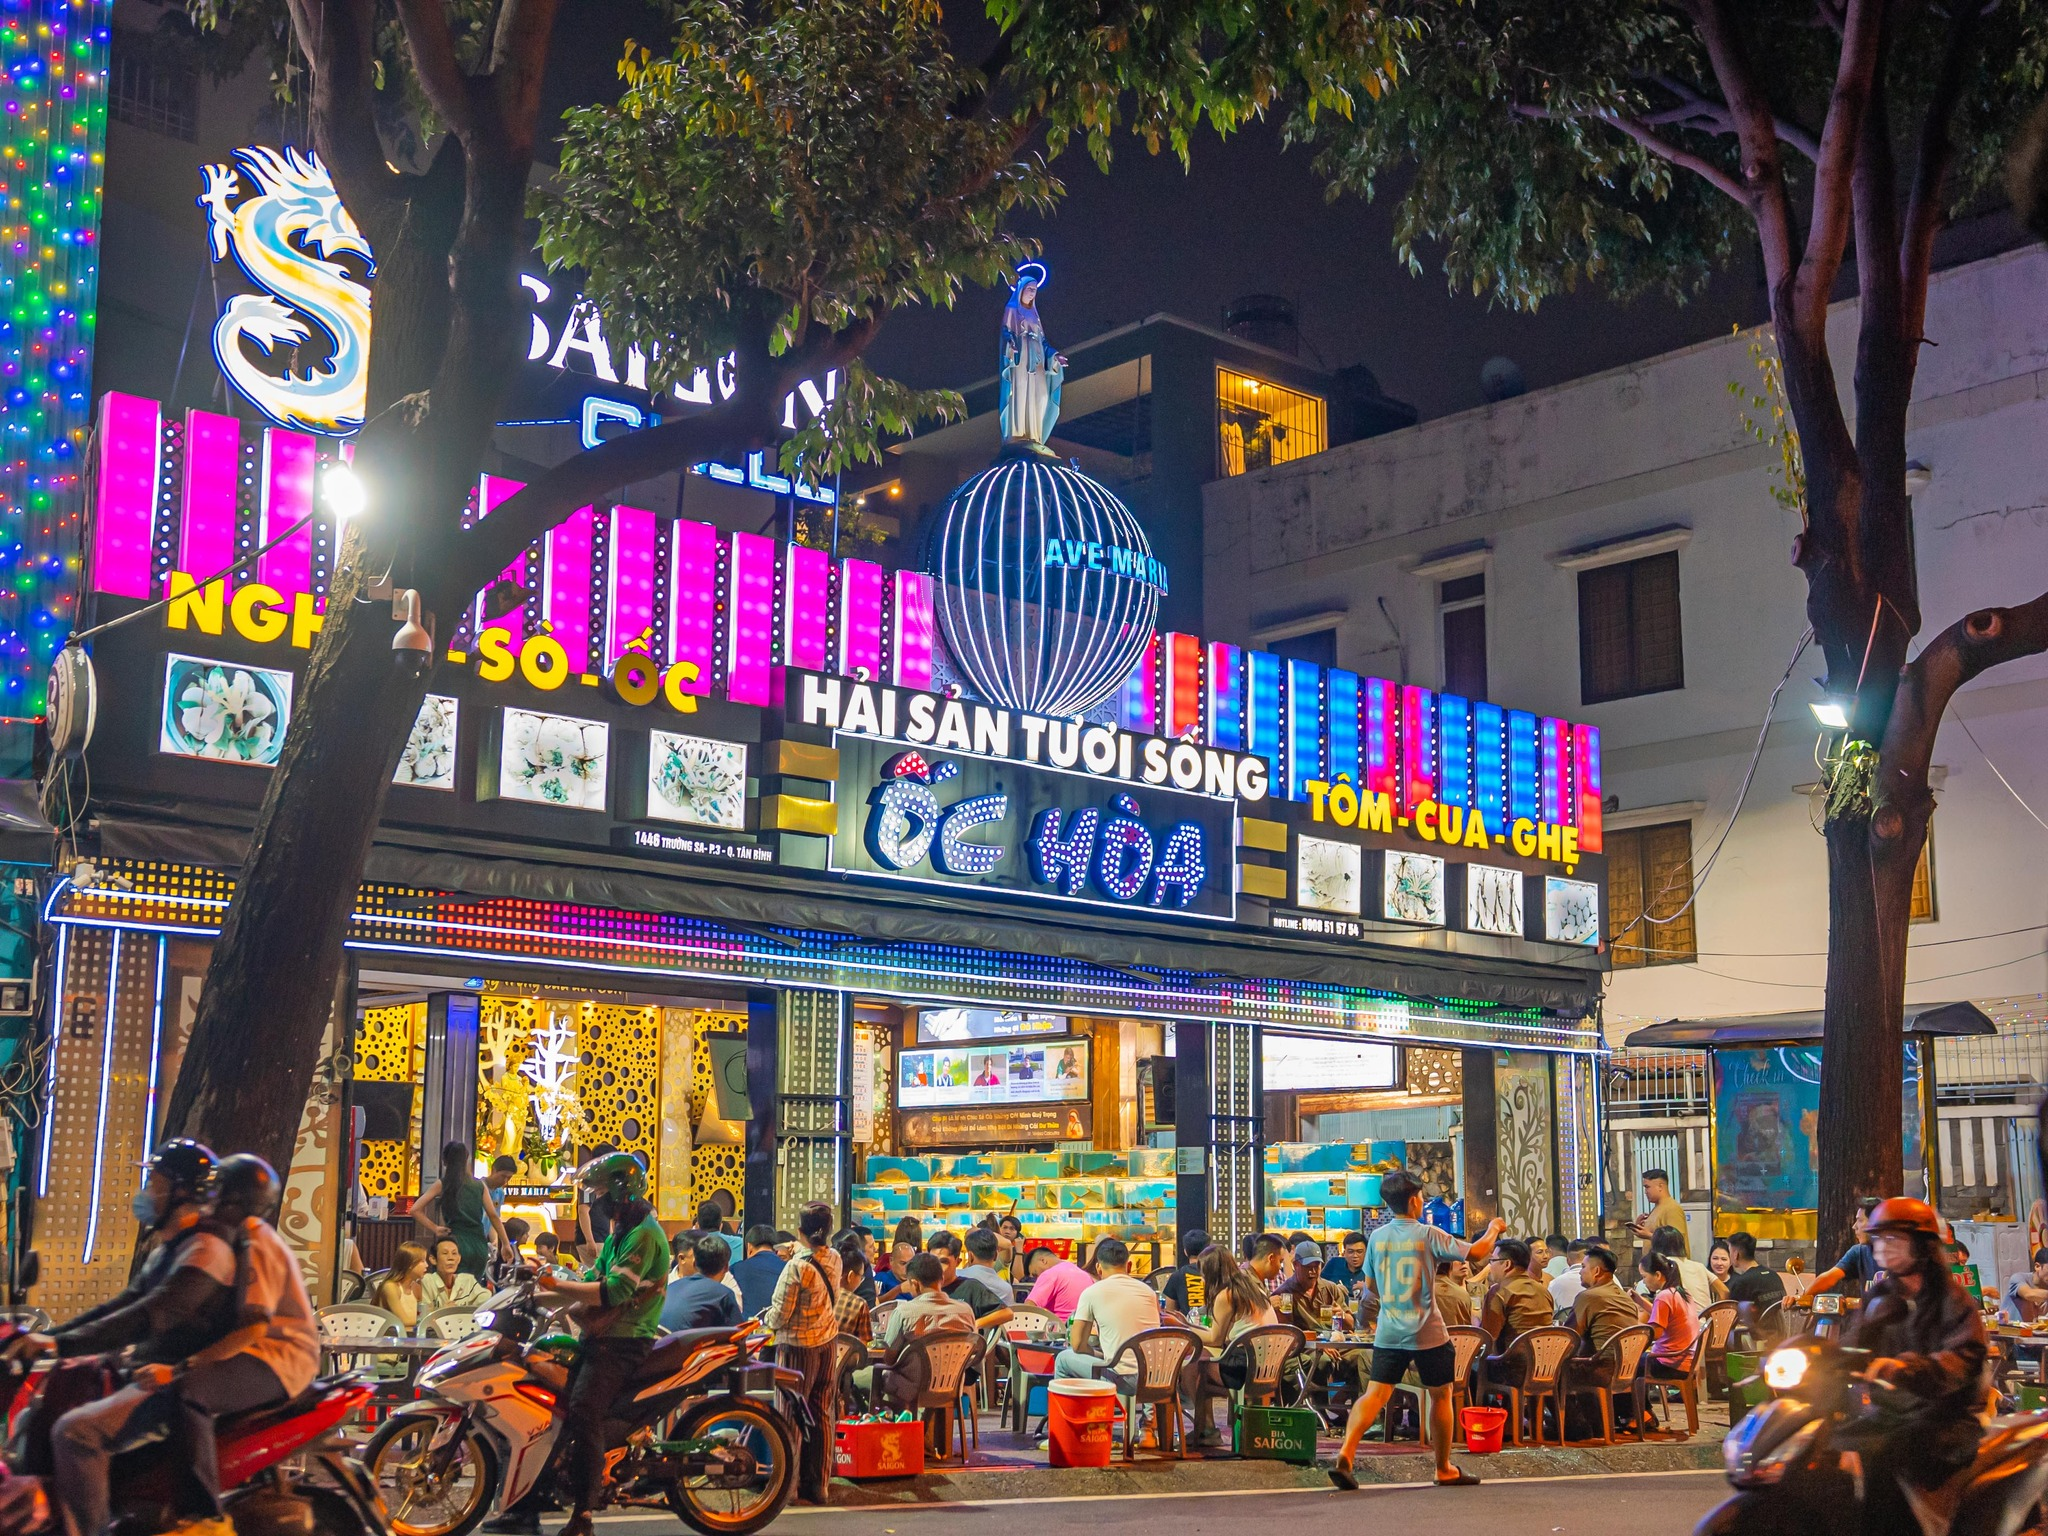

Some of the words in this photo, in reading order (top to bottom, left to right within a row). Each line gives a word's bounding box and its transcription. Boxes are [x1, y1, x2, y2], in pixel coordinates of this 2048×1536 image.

[1045, 537, 1104, 571] AVE
[1110, 545, 1169, 595] MARIA
[802, 666, 897, 737] HẢI
[904, 683, 1010, 758] SẢN
[1021, 713, 1133, 780] TƯƠI
[1143, 724, 1269, 802] SỐNG
[874, 749, 1009, 876] ỐC
[1035, 792, 1206, 908] HÒA
[1307, 773, 1393, 834] TÔM
[1415, 799, 1490, 850] CUA
[1511, 816, 1581, 876] GHẸ
[634, 830, 661, 848] 1446
[661, 836, 693, 852] TRƯỜNG
[736, 845, 752, 860] TÂN
[752, 847, 772, 862] BÌNH
[1323, 920, 1335, 934] 51
[1335, 921, 1347, 936] 57
[1347, 923, 1359, 937] 54
[1185, 1273, 1206, 1307] CRAZY
[1378, 1256, 1422, 1303] 19
[1253, 1436, 1303, 1450] SAIGON
[1270, 1430, 1286, 1438] BIA
[877, 1461, 906, 1470] SAIGON
